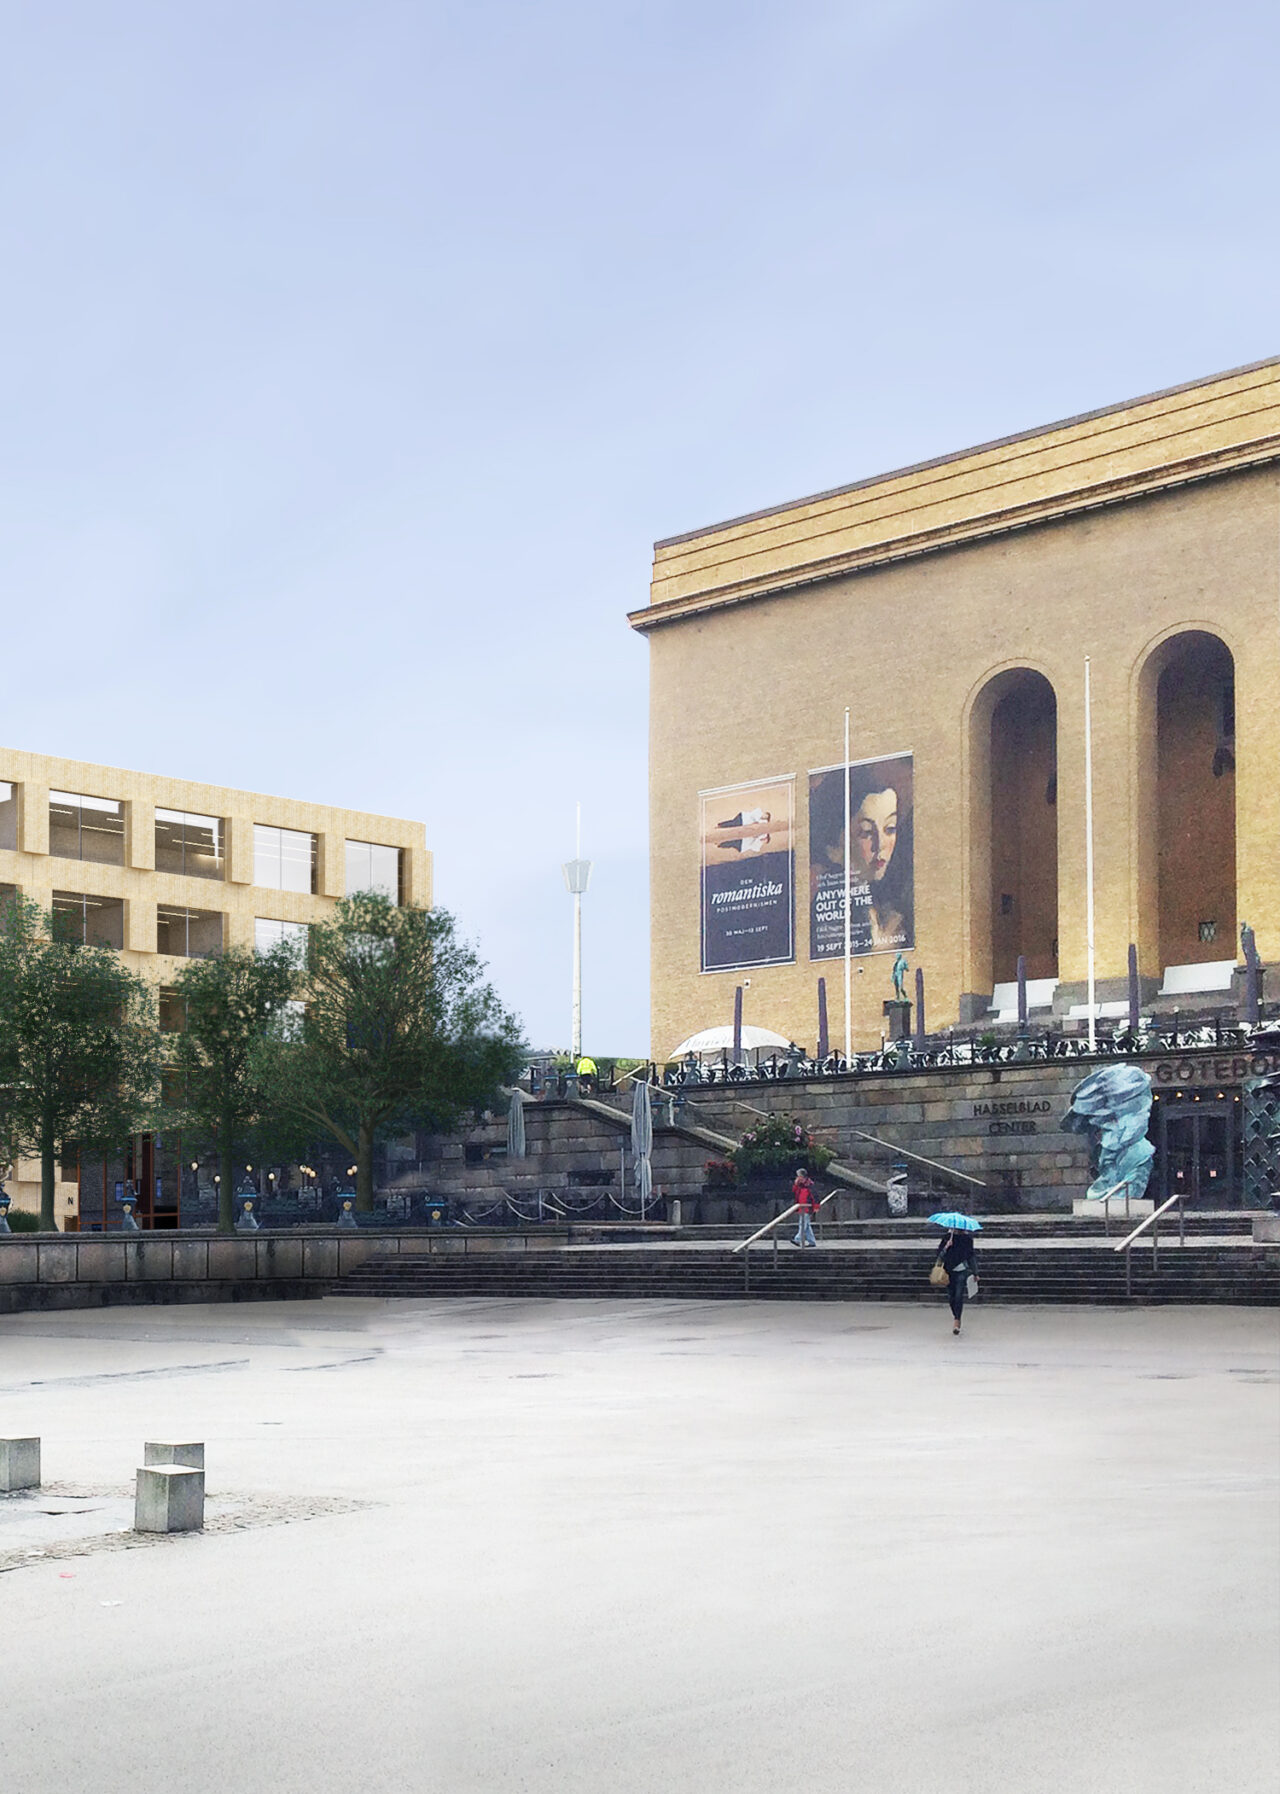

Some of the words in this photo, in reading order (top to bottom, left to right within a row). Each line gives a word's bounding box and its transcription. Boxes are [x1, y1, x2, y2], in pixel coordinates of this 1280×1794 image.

[711, 881, 783, 905] romantiska
[816, 900, 837, 912] OUT
[854, 895, 873, 906] THE
[816, 910, 851, 922] WORL
[973, 1100, 1052, 1116] HASSELBLAD
